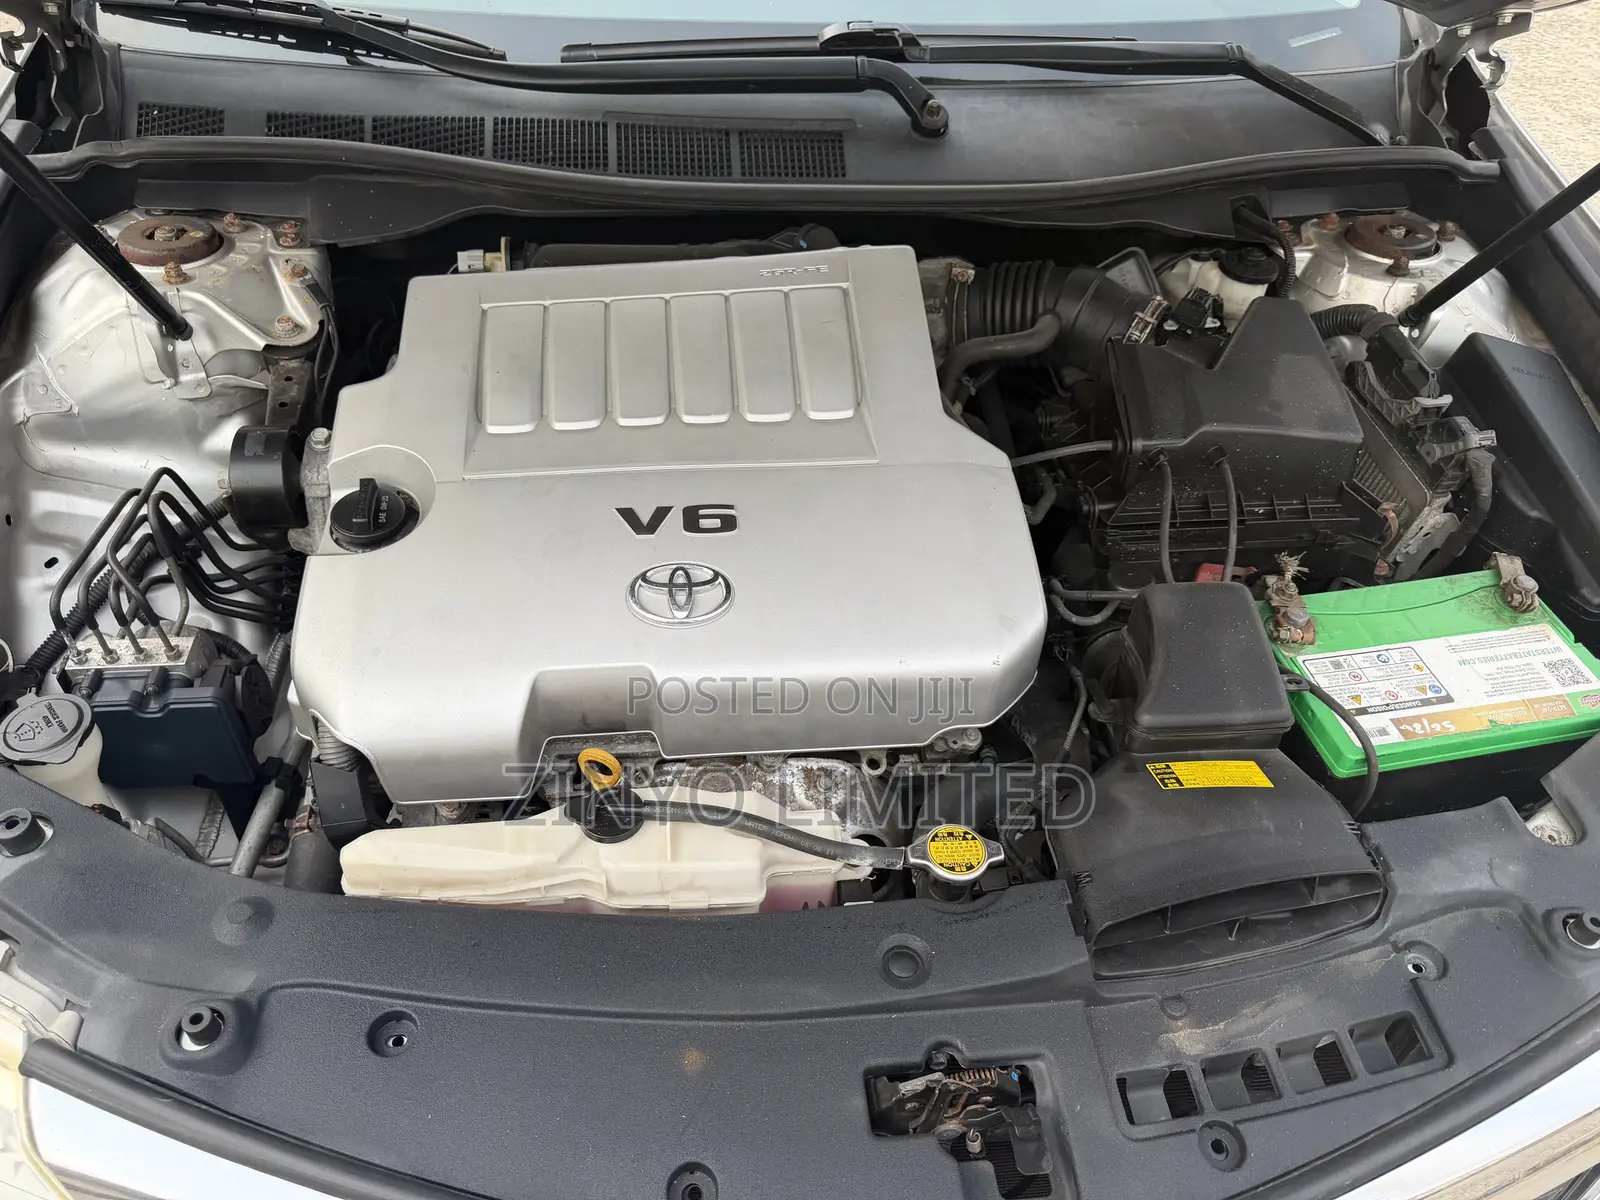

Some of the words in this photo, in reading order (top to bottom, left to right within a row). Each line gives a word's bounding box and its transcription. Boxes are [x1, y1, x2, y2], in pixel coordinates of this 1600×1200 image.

[381, 495, 389, 510] 0W-20
[613, 504, 739, 537] V6
[1457, 646, 1564, 667] INTERSTATEBATTERIES.COM
[744, 818, 768, 832] WATER
